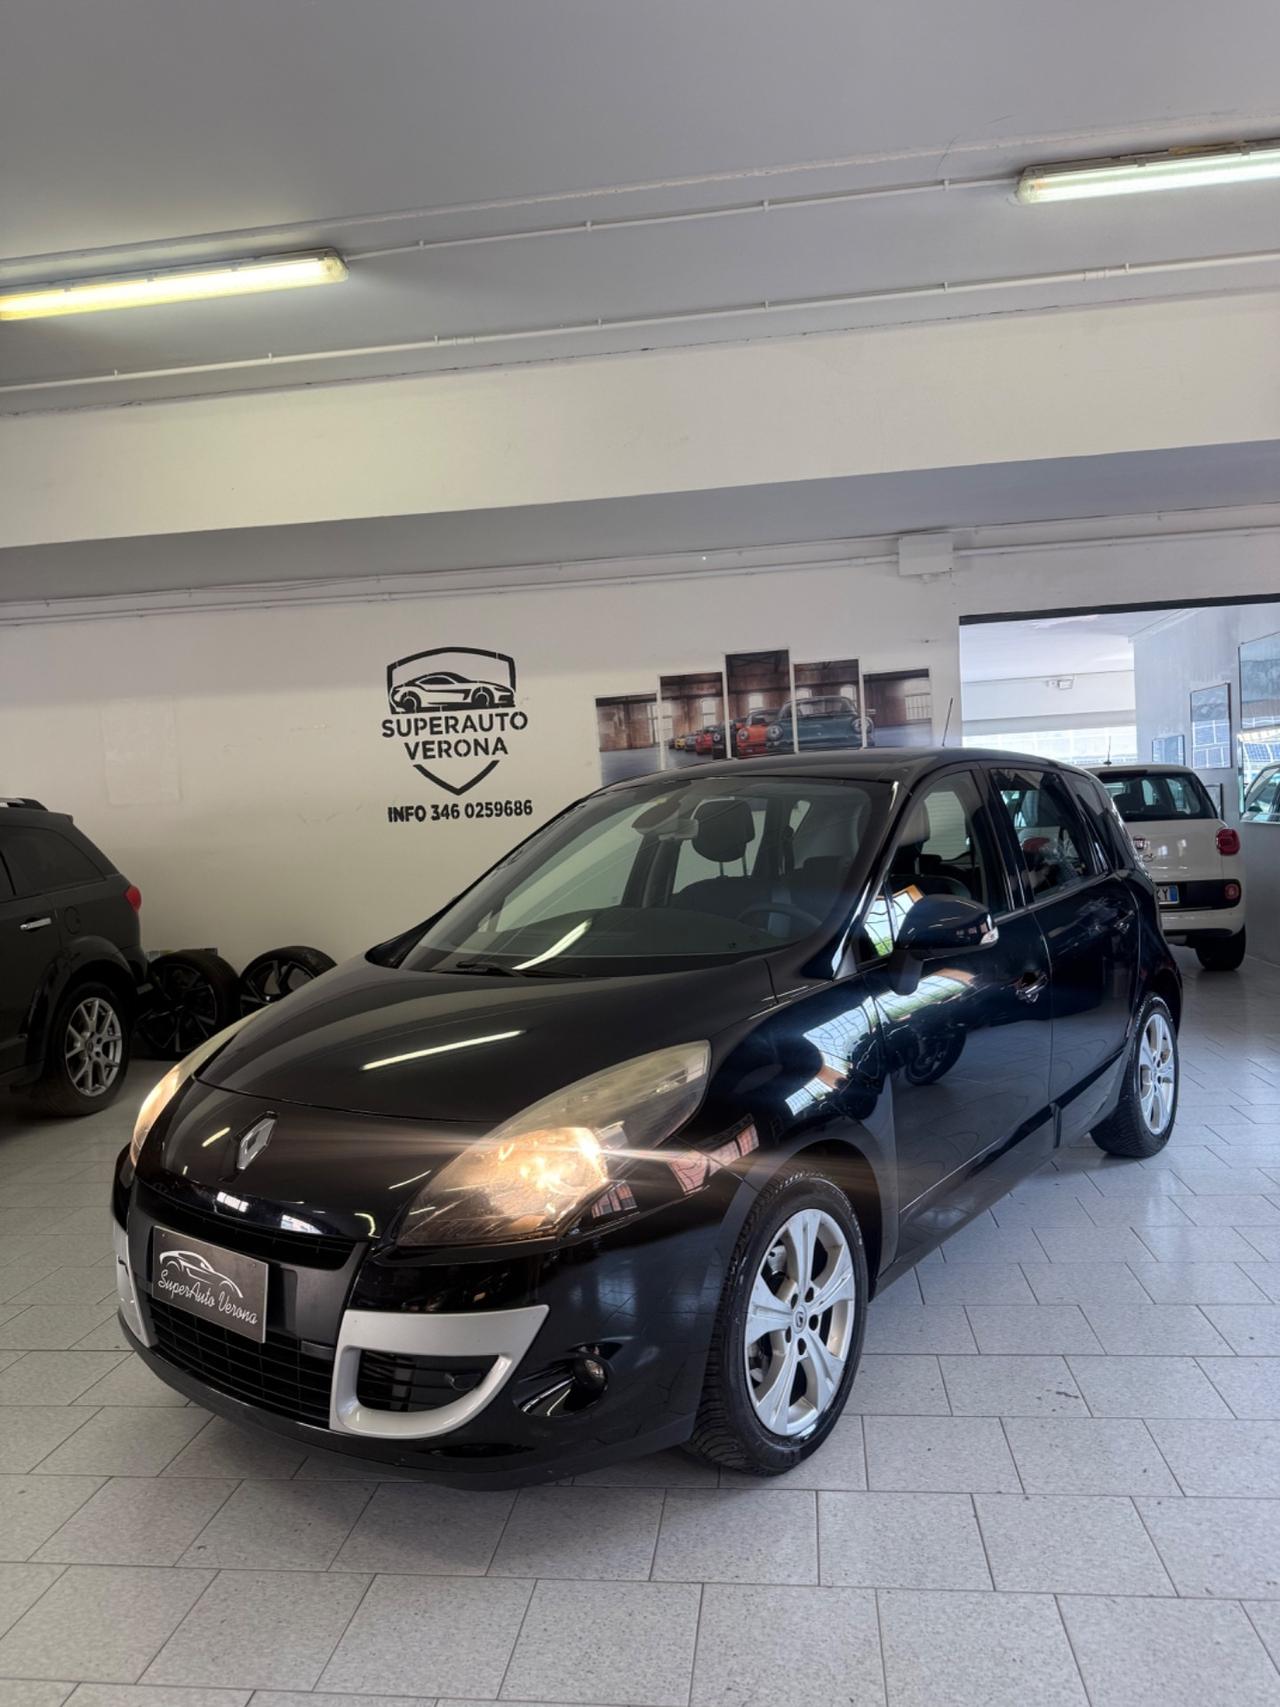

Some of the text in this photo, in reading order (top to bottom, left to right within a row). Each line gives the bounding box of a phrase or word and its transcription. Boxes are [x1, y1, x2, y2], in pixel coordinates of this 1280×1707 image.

[381, 711, 528, 738] SUPERAUTO
[404, 736, 509, 760] VERONA
[387, 799, 533, 823] INFO 346 0259686
[219, 1290, 258, 1325] Verona
